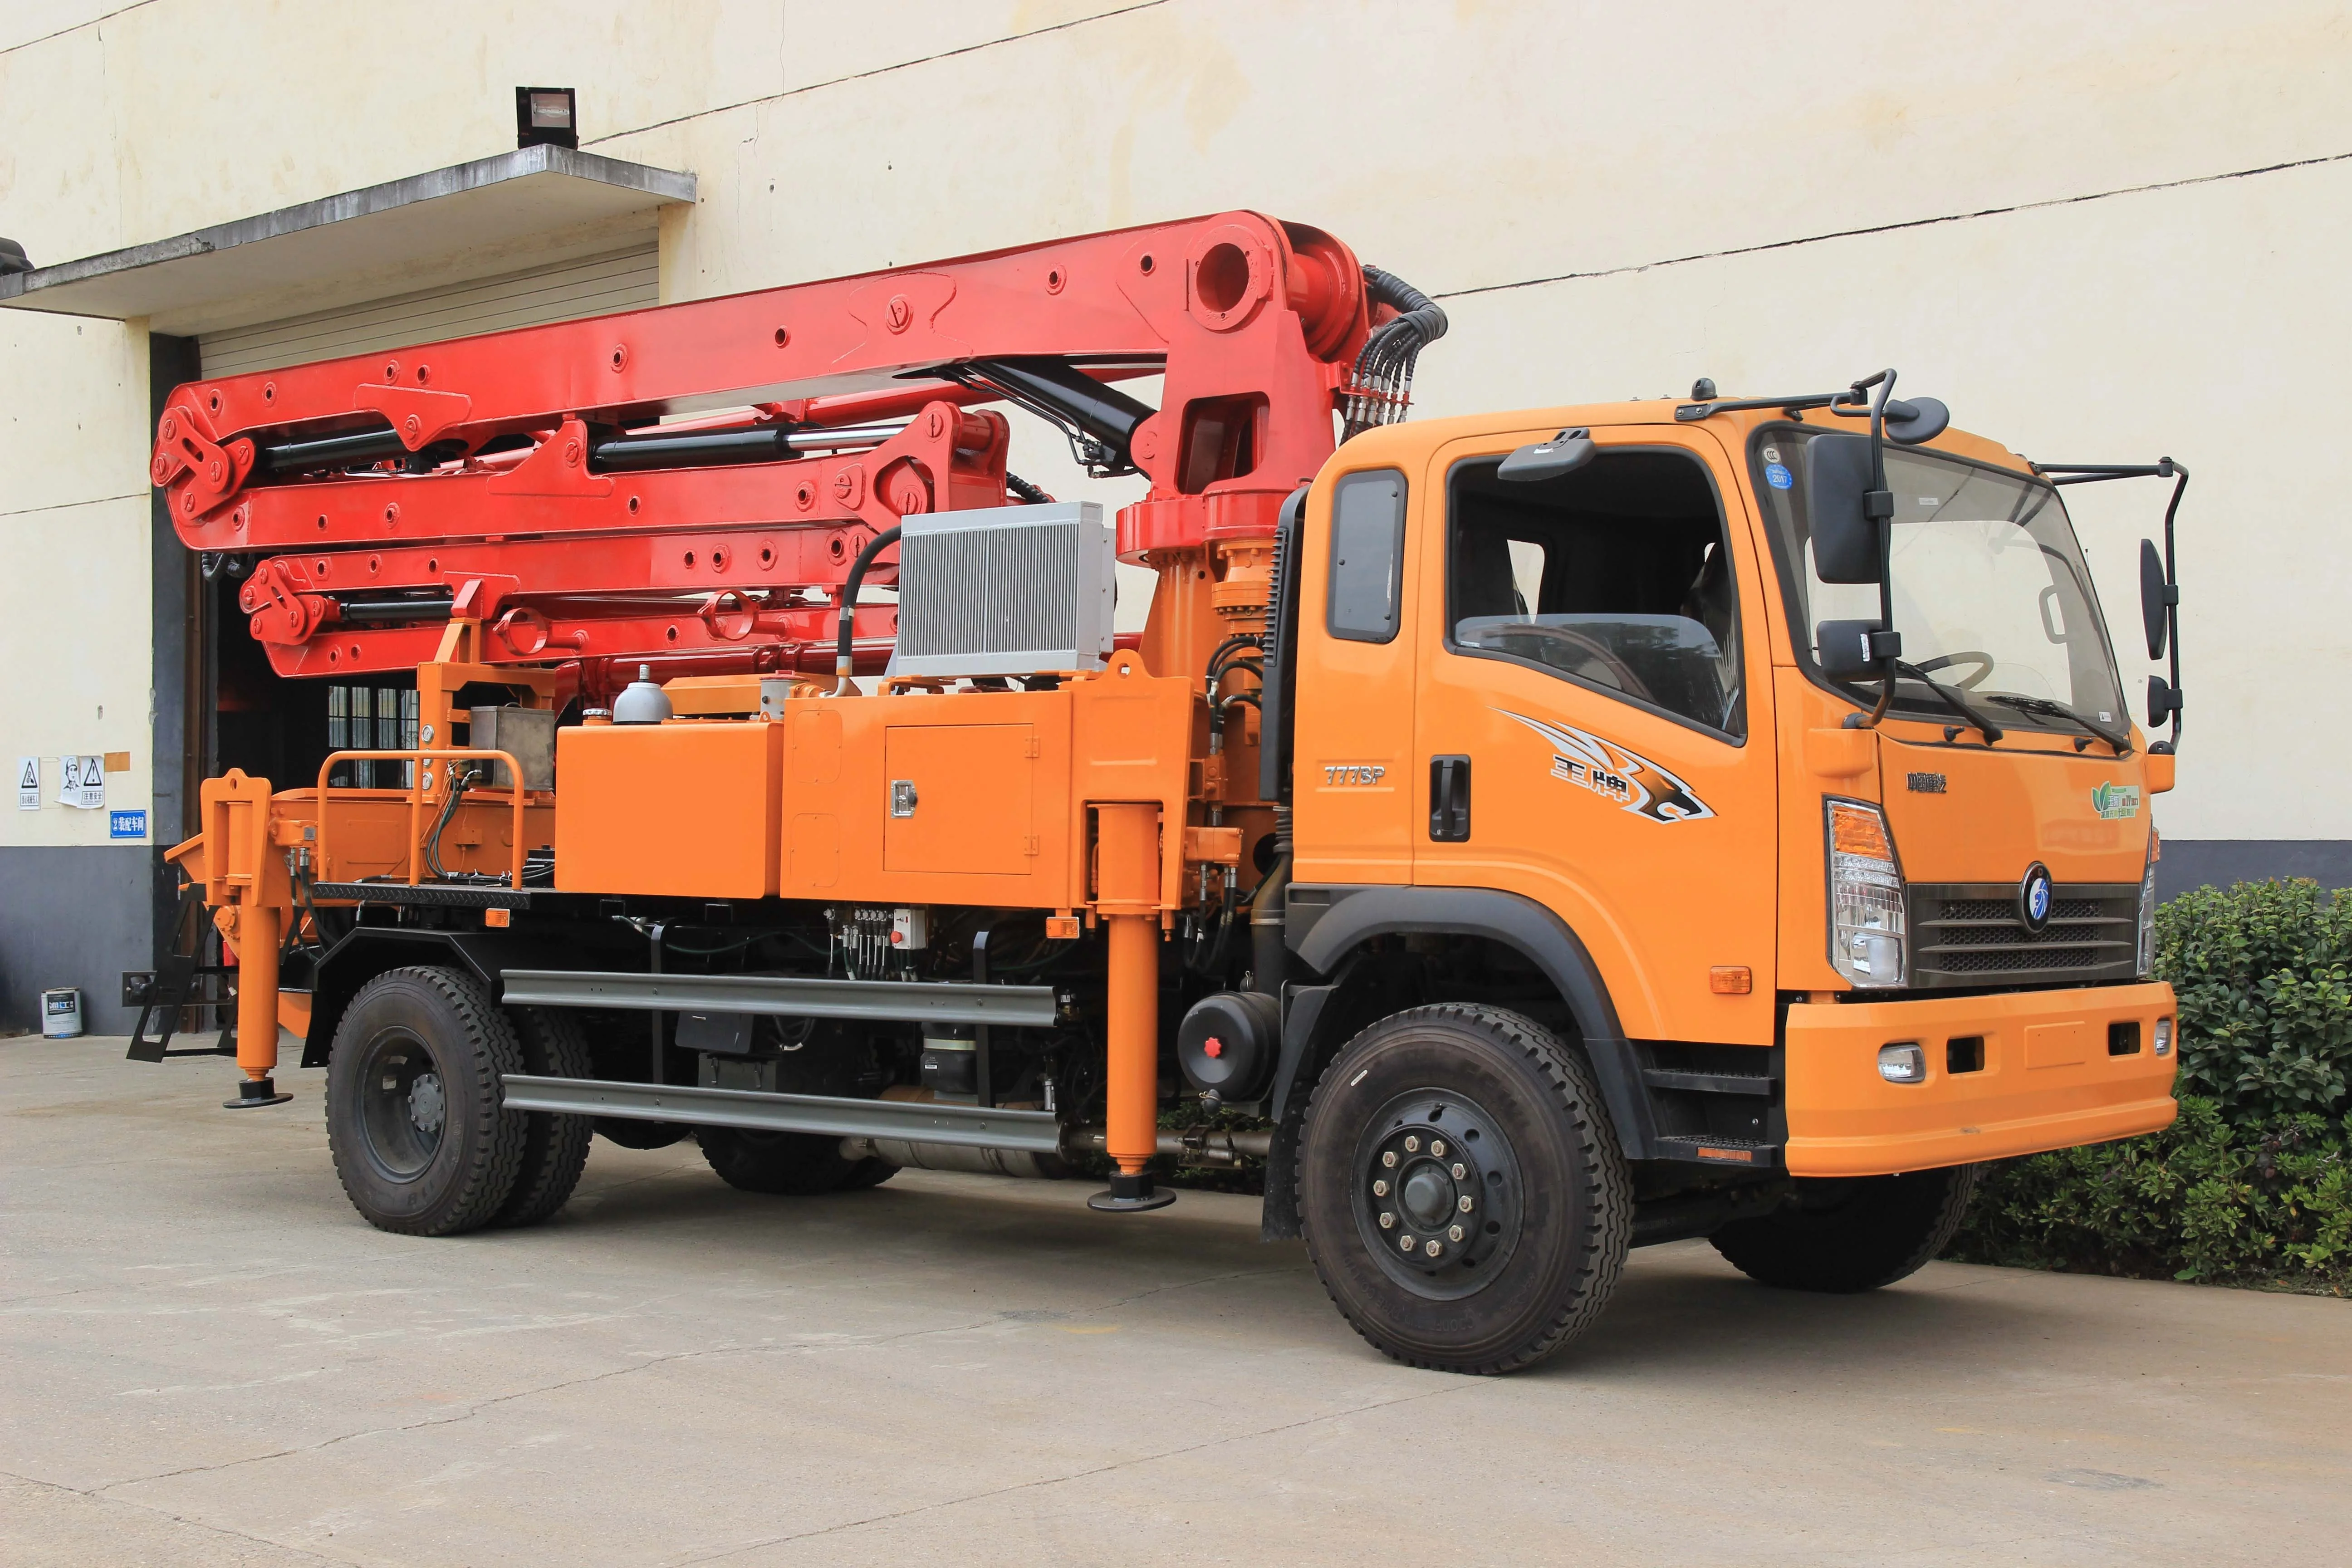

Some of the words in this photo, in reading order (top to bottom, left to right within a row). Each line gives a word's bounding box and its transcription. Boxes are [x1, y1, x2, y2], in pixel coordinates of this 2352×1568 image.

[1772, 475, 1787, 484] 2017
[1324, 765, 1385, 784] 777BP
[1550, 753, 1631, 803] 王牌
[83, 792, 102, 800] 注意安全
